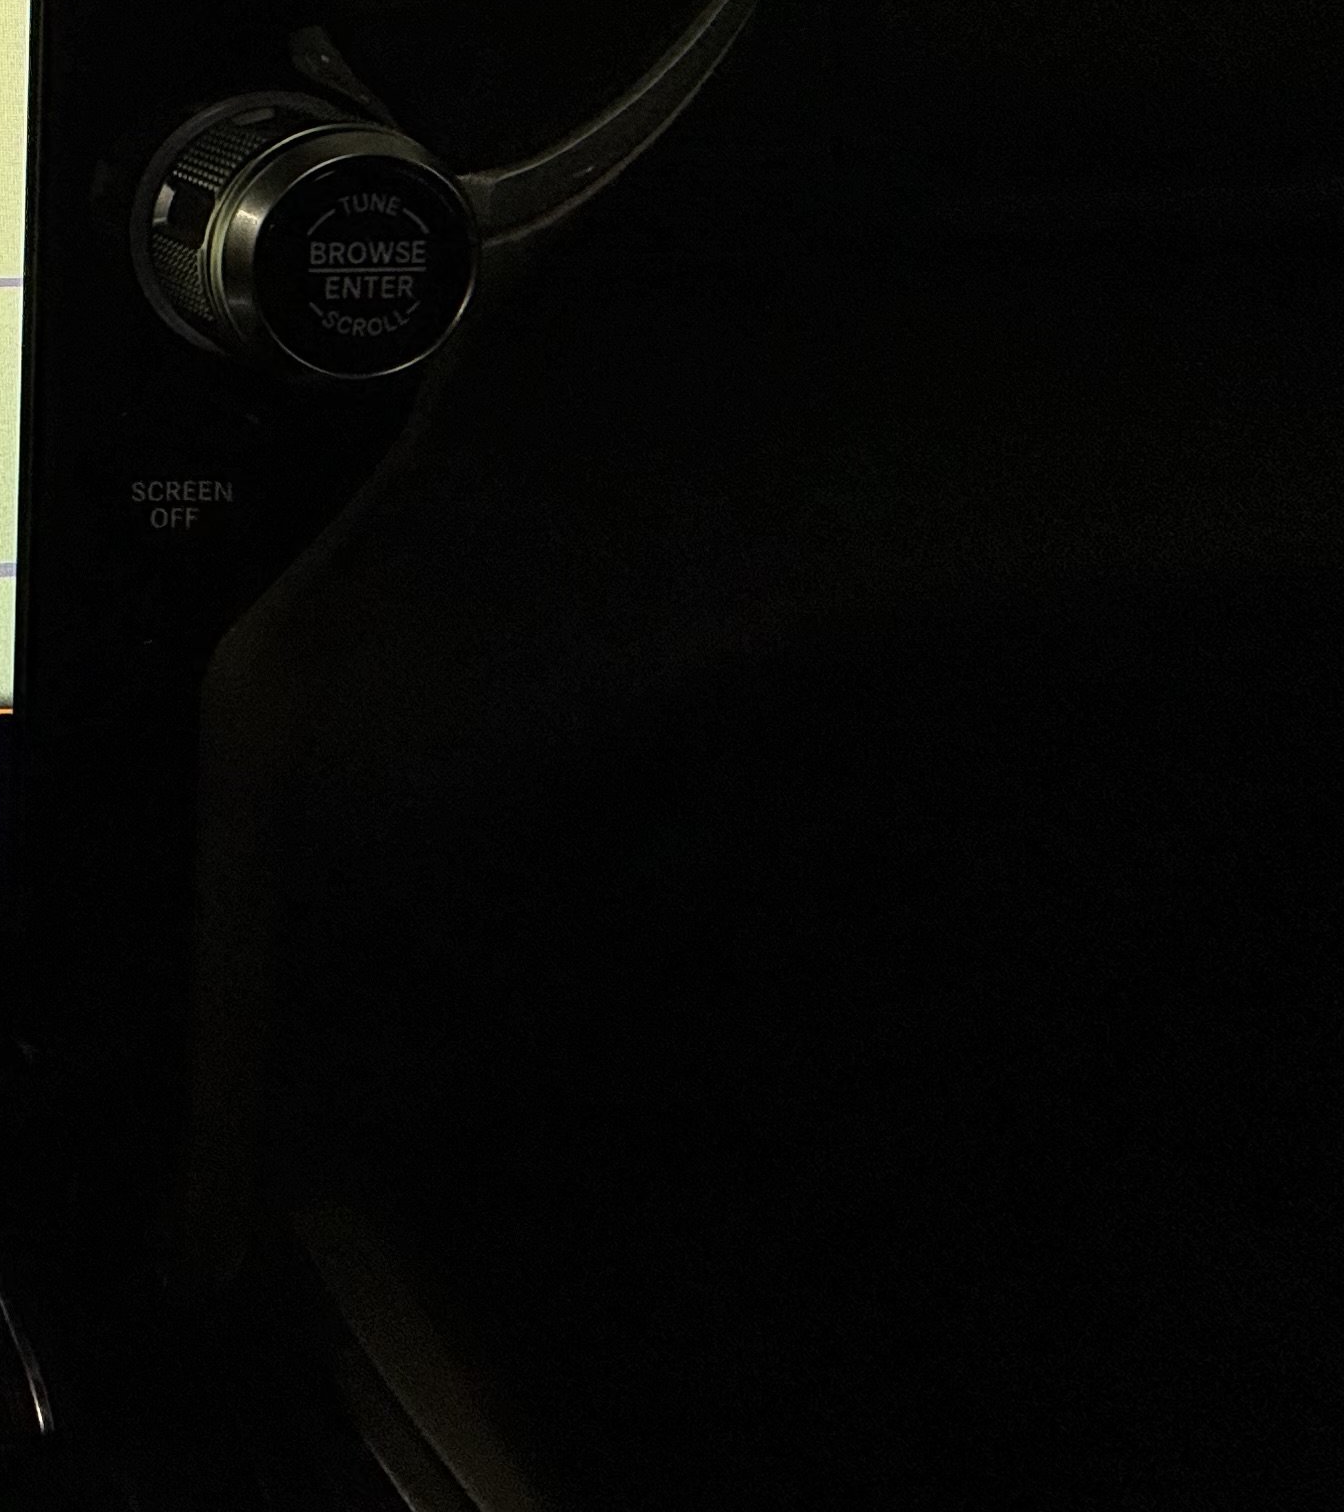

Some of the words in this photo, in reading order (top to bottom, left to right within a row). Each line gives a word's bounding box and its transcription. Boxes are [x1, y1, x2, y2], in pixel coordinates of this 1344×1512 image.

[337, 191, 402, 219] TUNE
[309, 239, 427, 266] BROWSE
[324, 274, 415, 301] ENTER
[320, 306, 412, 338] SCROLL
[130, 479, 234, 504] SCREEN
[149, 506, 200, 530] OFF
